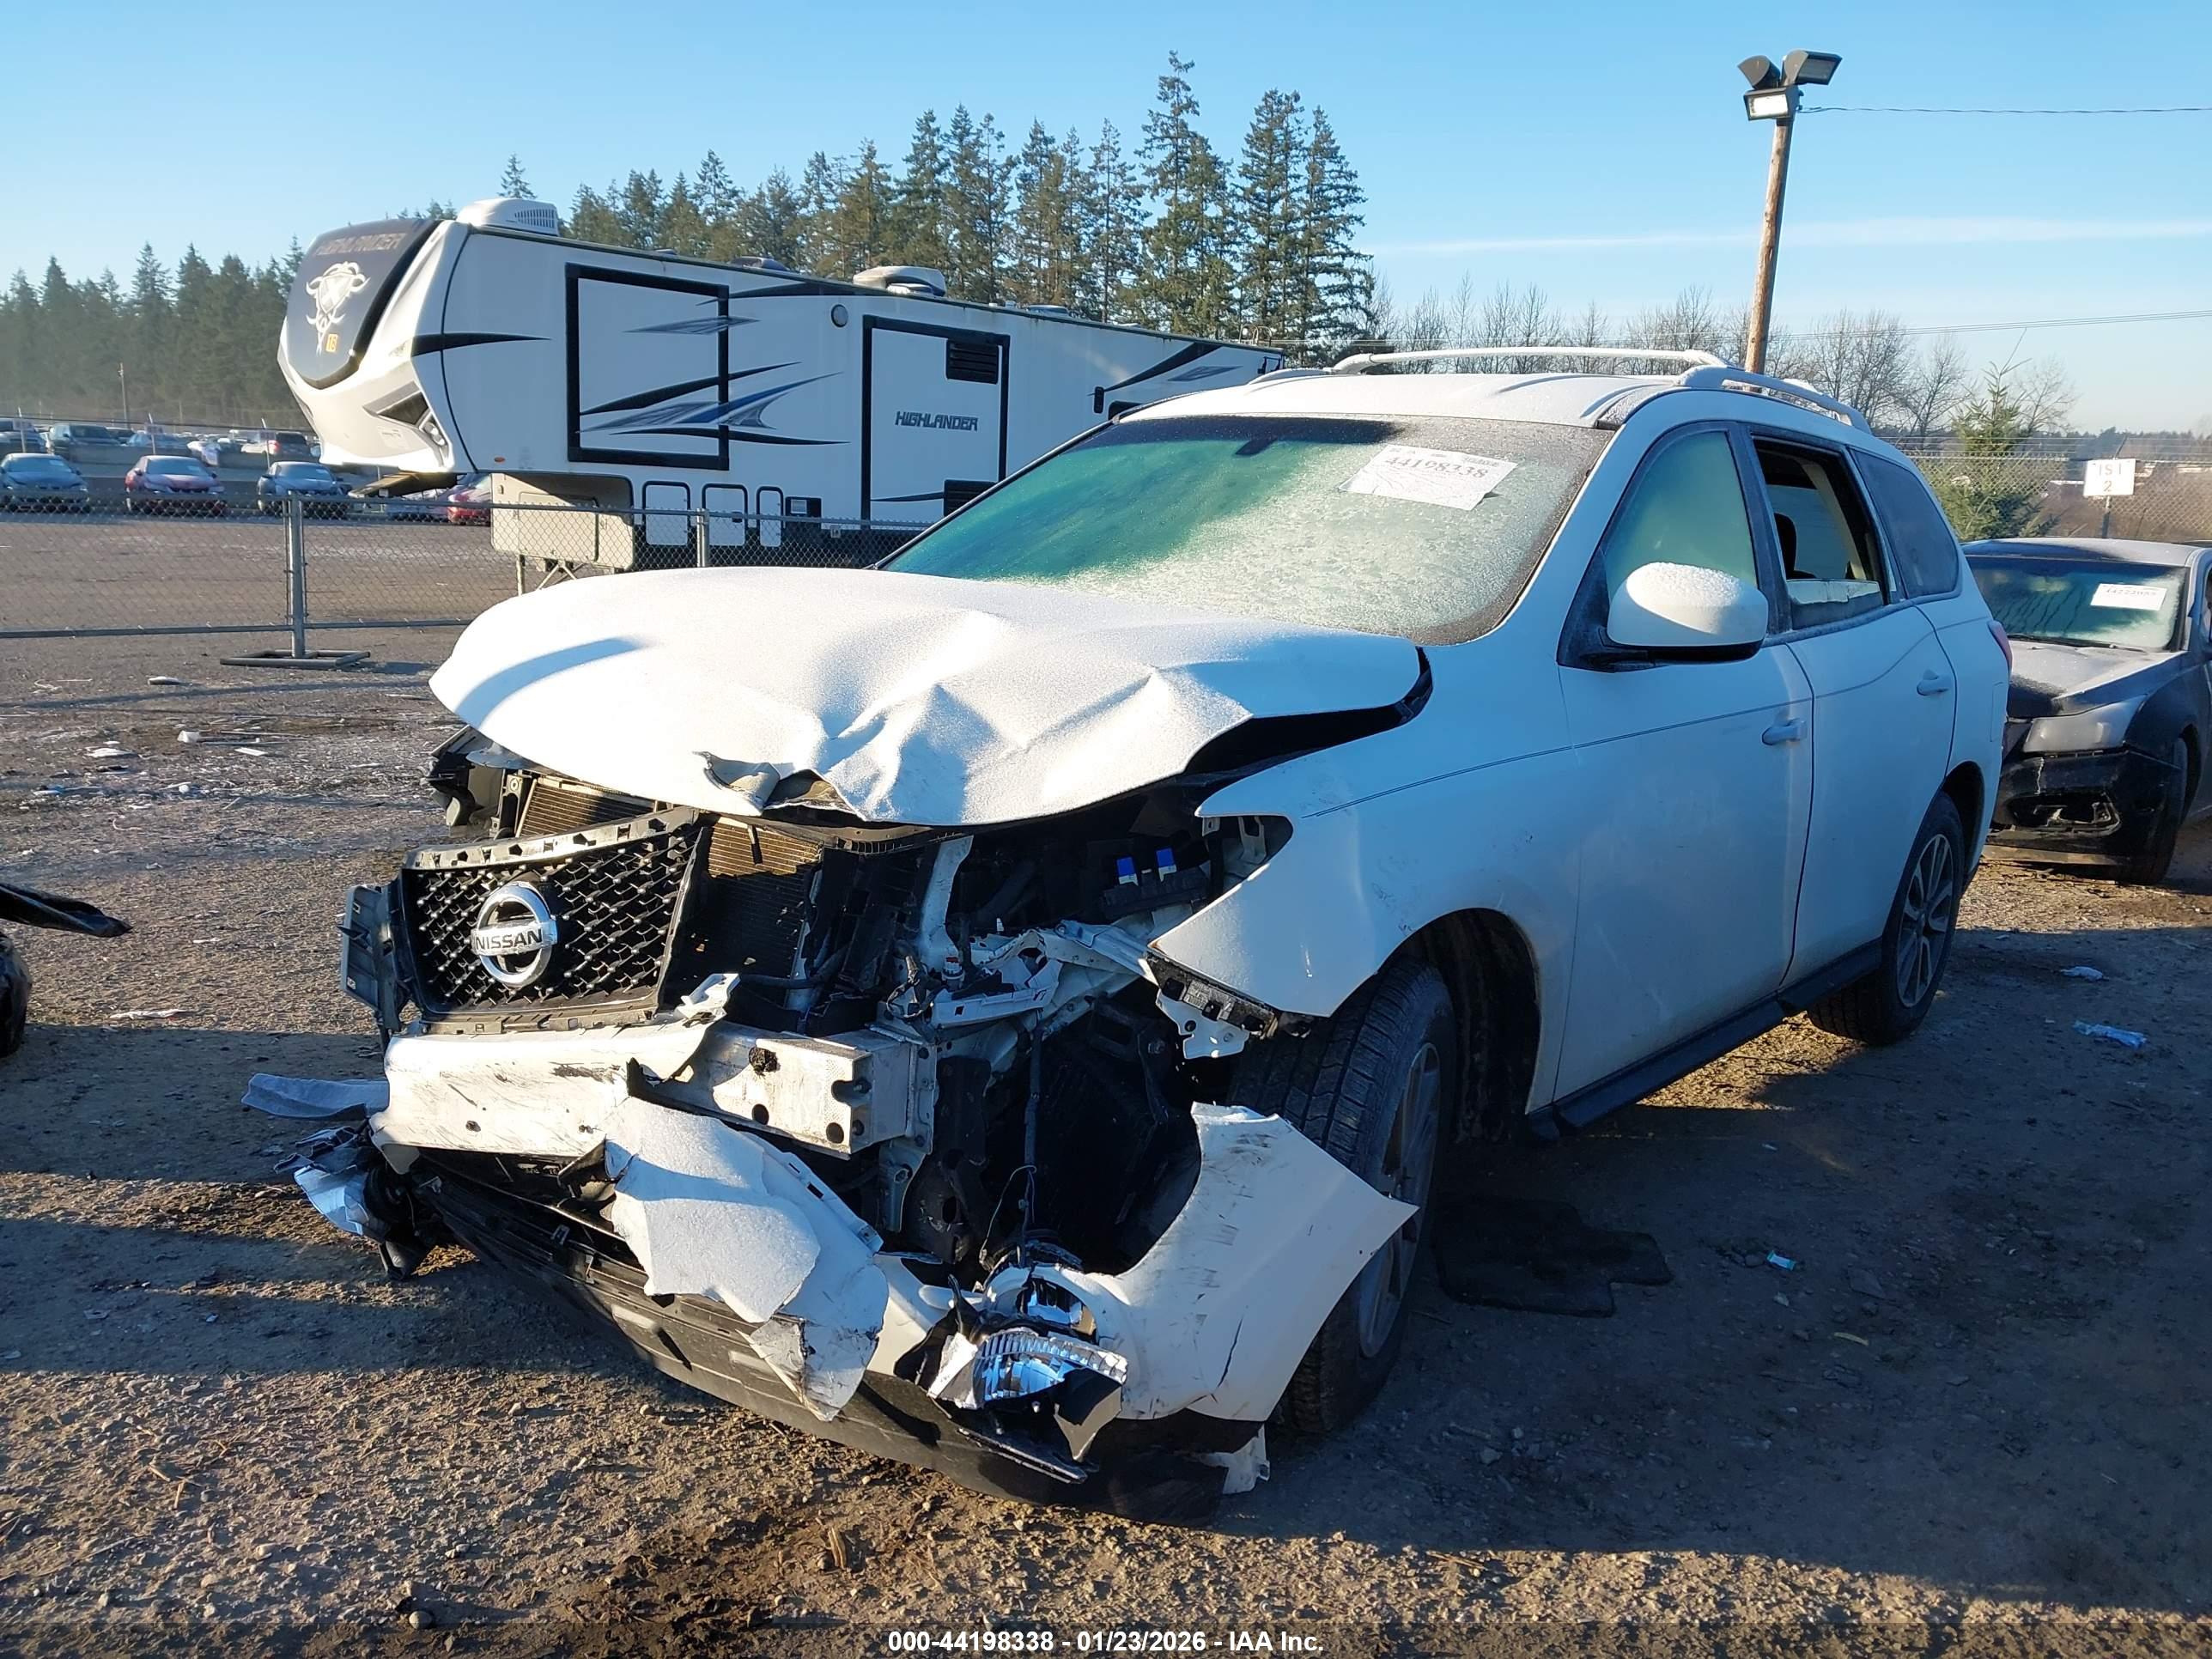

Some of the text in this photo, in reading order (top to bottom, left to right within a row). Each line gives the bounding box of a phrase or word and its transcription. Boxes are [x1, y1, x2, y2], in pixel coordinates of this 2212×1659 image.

[895, 411, 978, 431] HIGHLANDER
[1385, 456, 1488, 478] 44198338
[2103, 480, 2112, 492] 2
[475, 928, 543, 951] NISSAN
